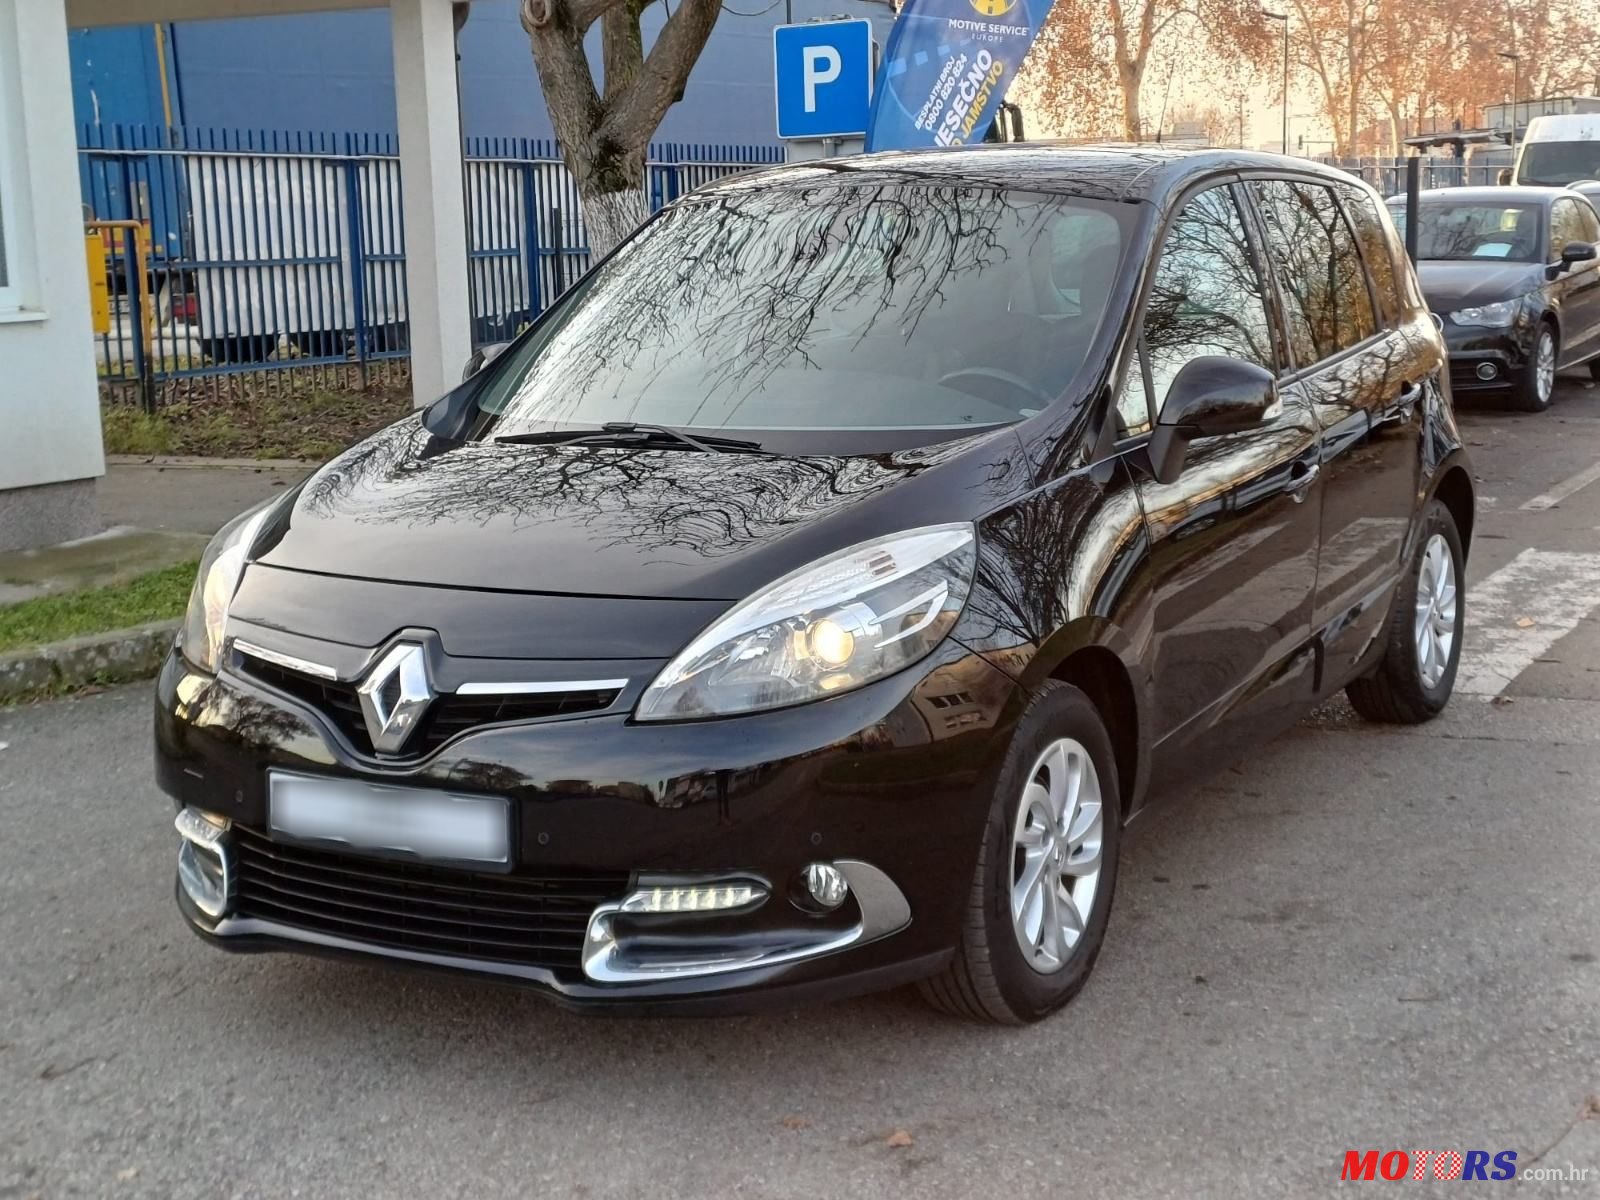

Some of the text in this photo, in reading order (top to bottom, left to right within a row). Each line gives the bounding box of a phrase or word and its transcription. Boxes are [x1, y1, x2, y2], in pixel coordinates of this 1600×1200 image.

[948, 19, 1028, 36] MOTIVE SERVICE
[971, 33, 1003, 42] EUROPE
[803, 45, 842, 112] P
[924, 53, 967, 130] 0800 820 824
[961, 61, 1003, 139] JAMSTVO
